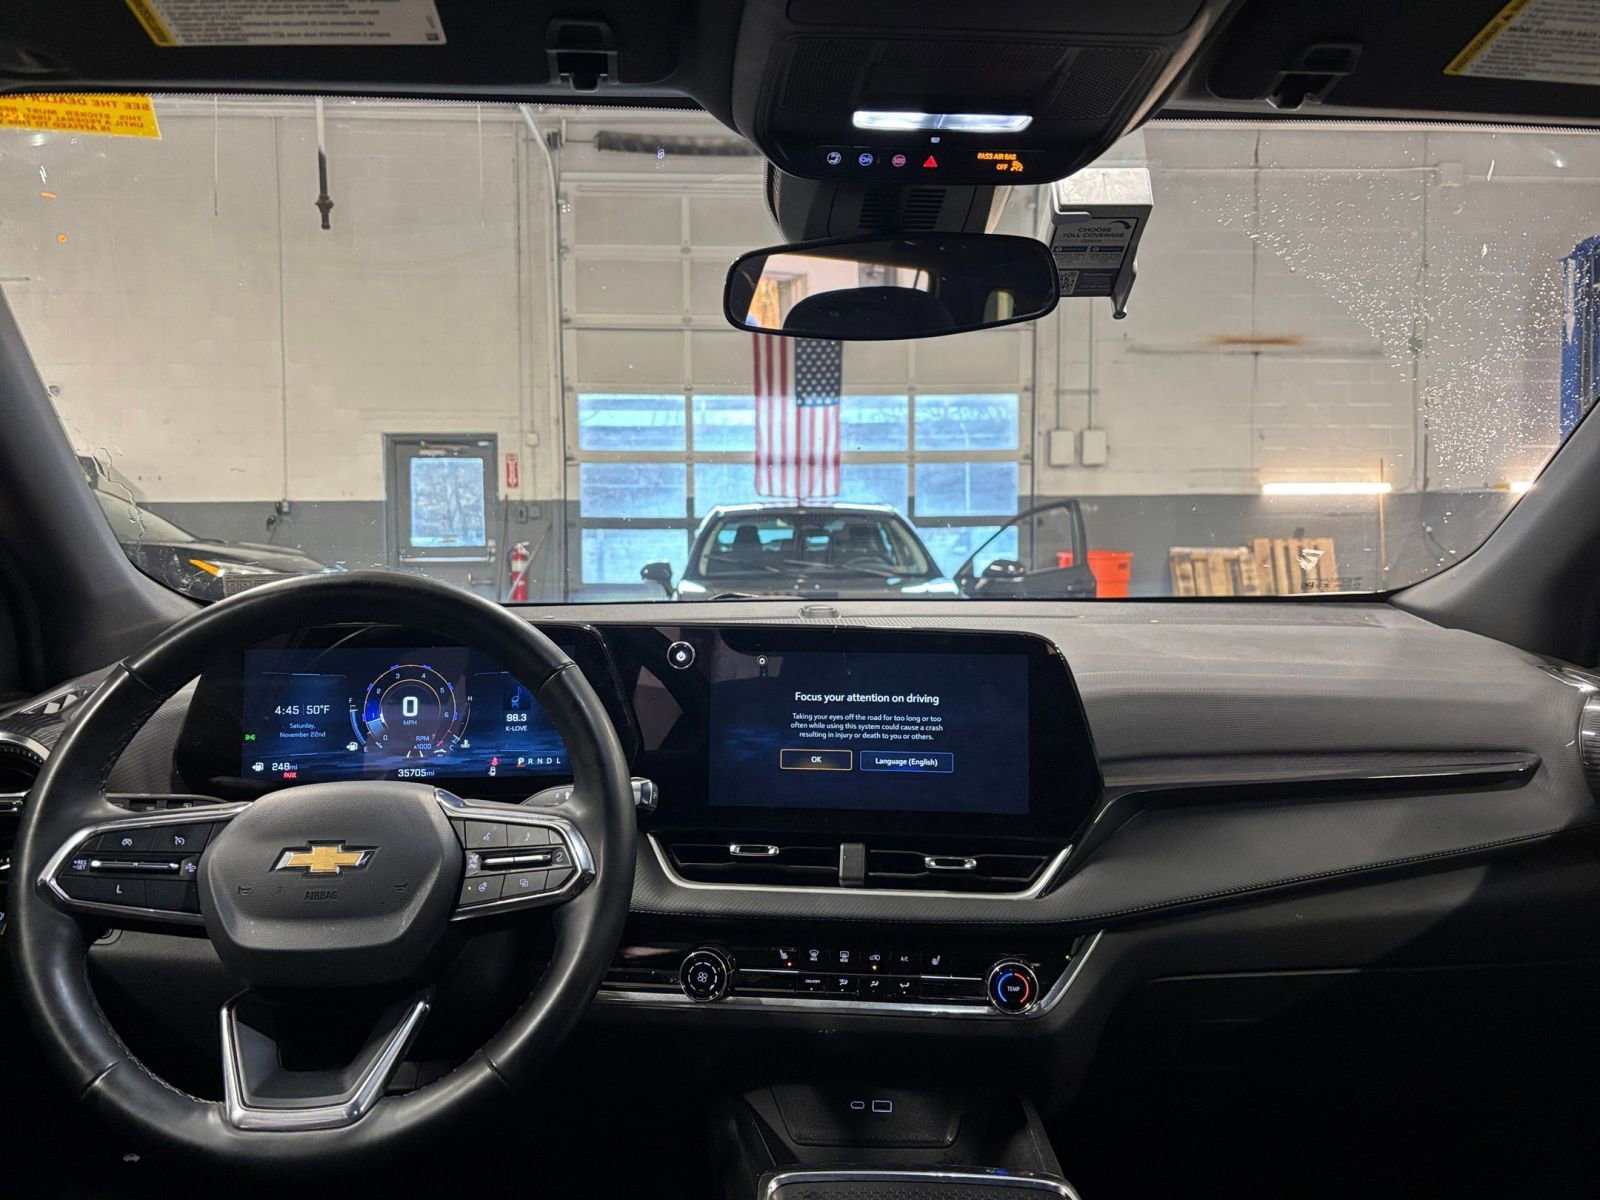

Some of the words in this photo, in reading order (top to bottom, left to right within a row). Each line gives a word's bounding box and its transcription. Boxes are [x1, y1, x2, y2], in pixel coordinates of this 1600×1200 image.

[795, 691, 822, 701] Focus
[824, 695, 845, 703] your
[847, 693, 889, 702] attention
[907, 693, 939, 705] driving
[274, 705, 300, 715] 4:45
[306, 704, 330, 714] 50°F
[403, 696, 418, 717] 0
[506, 713, 527, 721] 98.3
[792, 713, 812, 721] Taking
[906, 715, 920, 723] long
[799, 731, 826, 739] resulting
[876, 758, 907, 766] Language
[909, 758, 937, 767] (English)
[304, 891, 338, 900] AIRBAG
